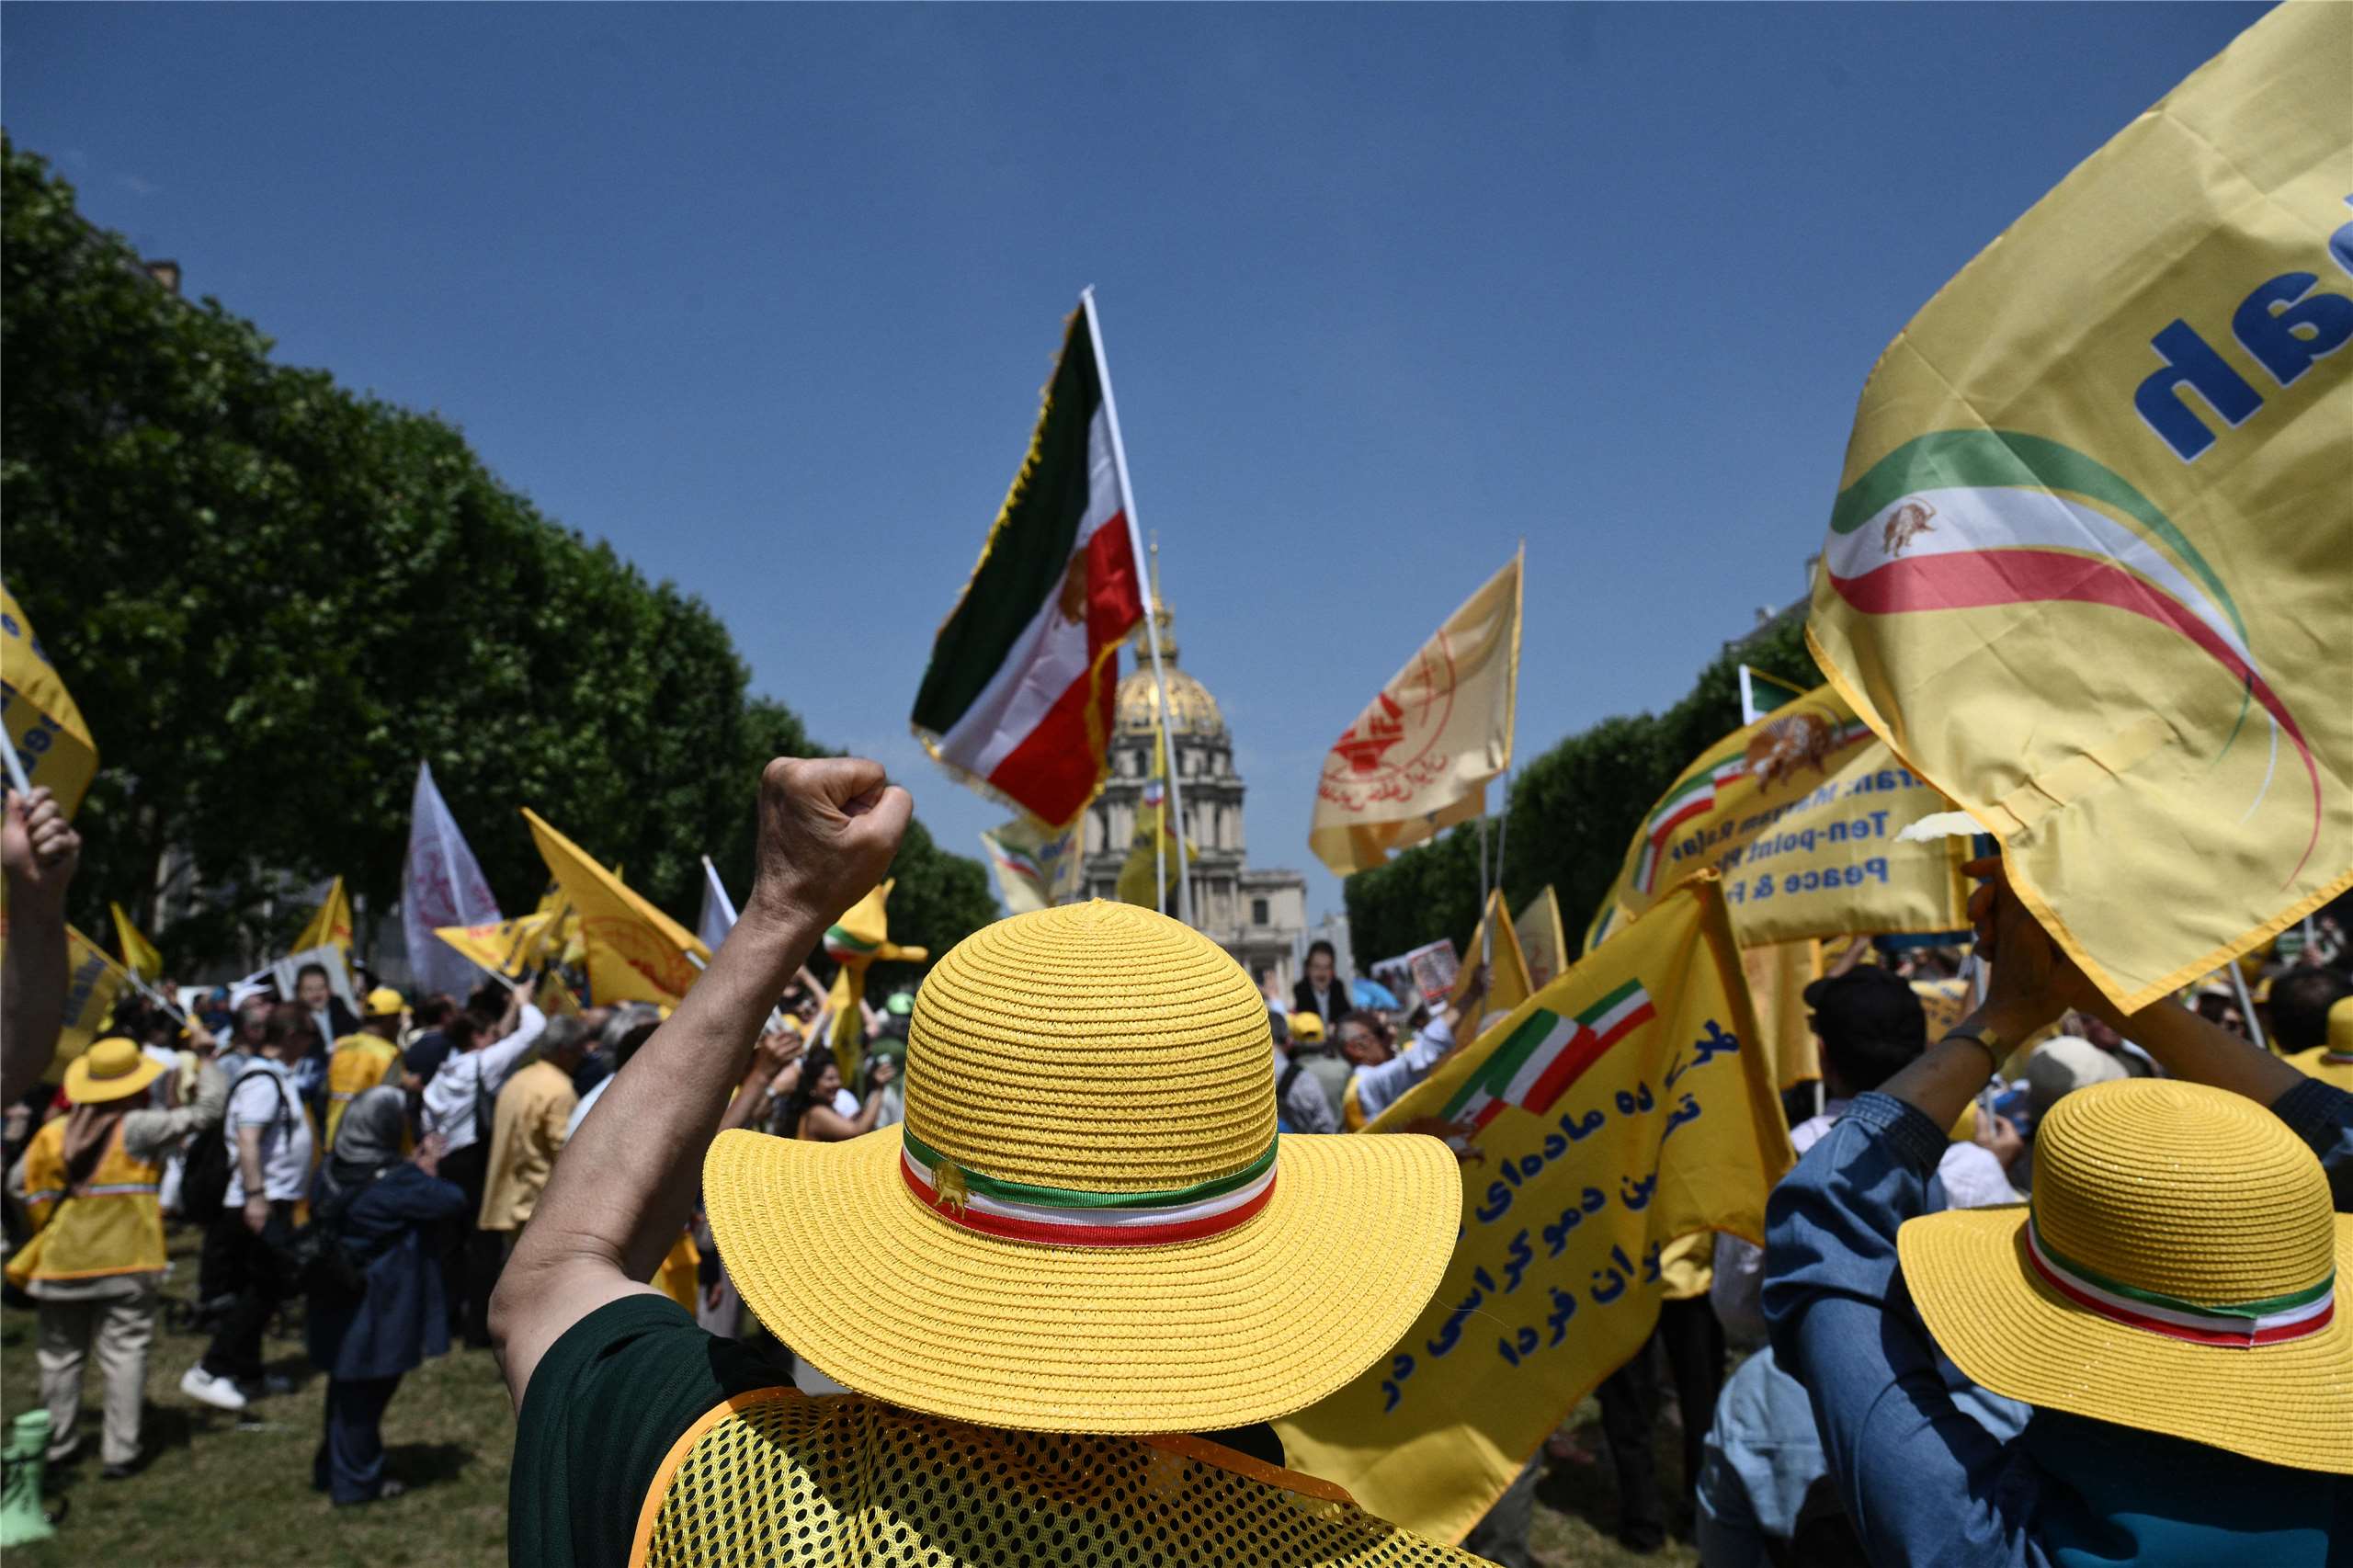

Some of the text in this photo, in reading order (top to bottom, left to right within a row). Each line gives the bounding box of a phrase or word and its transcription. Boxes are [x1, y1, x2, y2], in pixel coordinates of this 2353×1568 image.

[1616, 1081, 1654, 1115] ده
[1498, 1287, 1577, 1368] فردا
[1381, 1353, 1415, 1413] در
